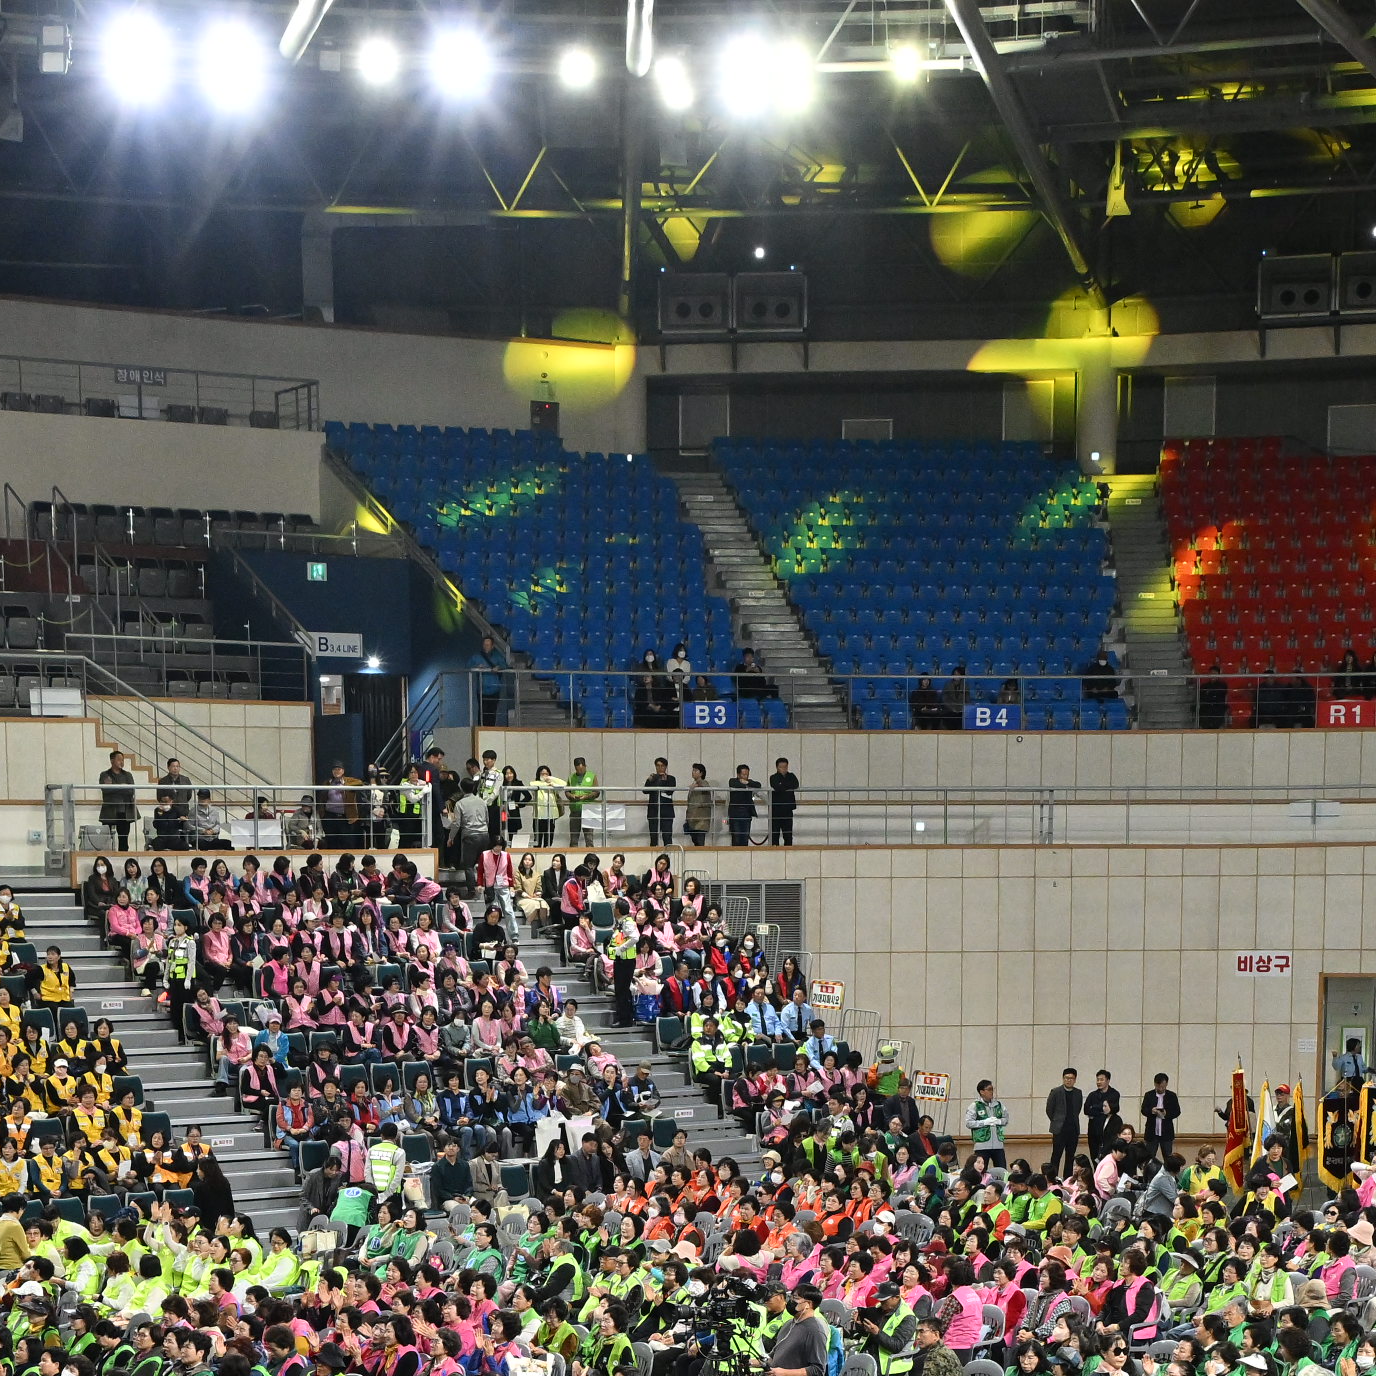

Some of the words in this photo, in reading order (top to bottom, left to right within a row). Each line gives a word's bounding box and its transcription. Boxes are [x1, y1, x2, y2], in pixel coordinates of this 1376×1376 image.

[117, 369, 164, 385] 장애인석
[695, 705, 726, 724] B3
[976, 707, 1008, 727] B4
[1329, 704, 1363, 724] R1
[1236, 953, 1291, 973] 비상구
